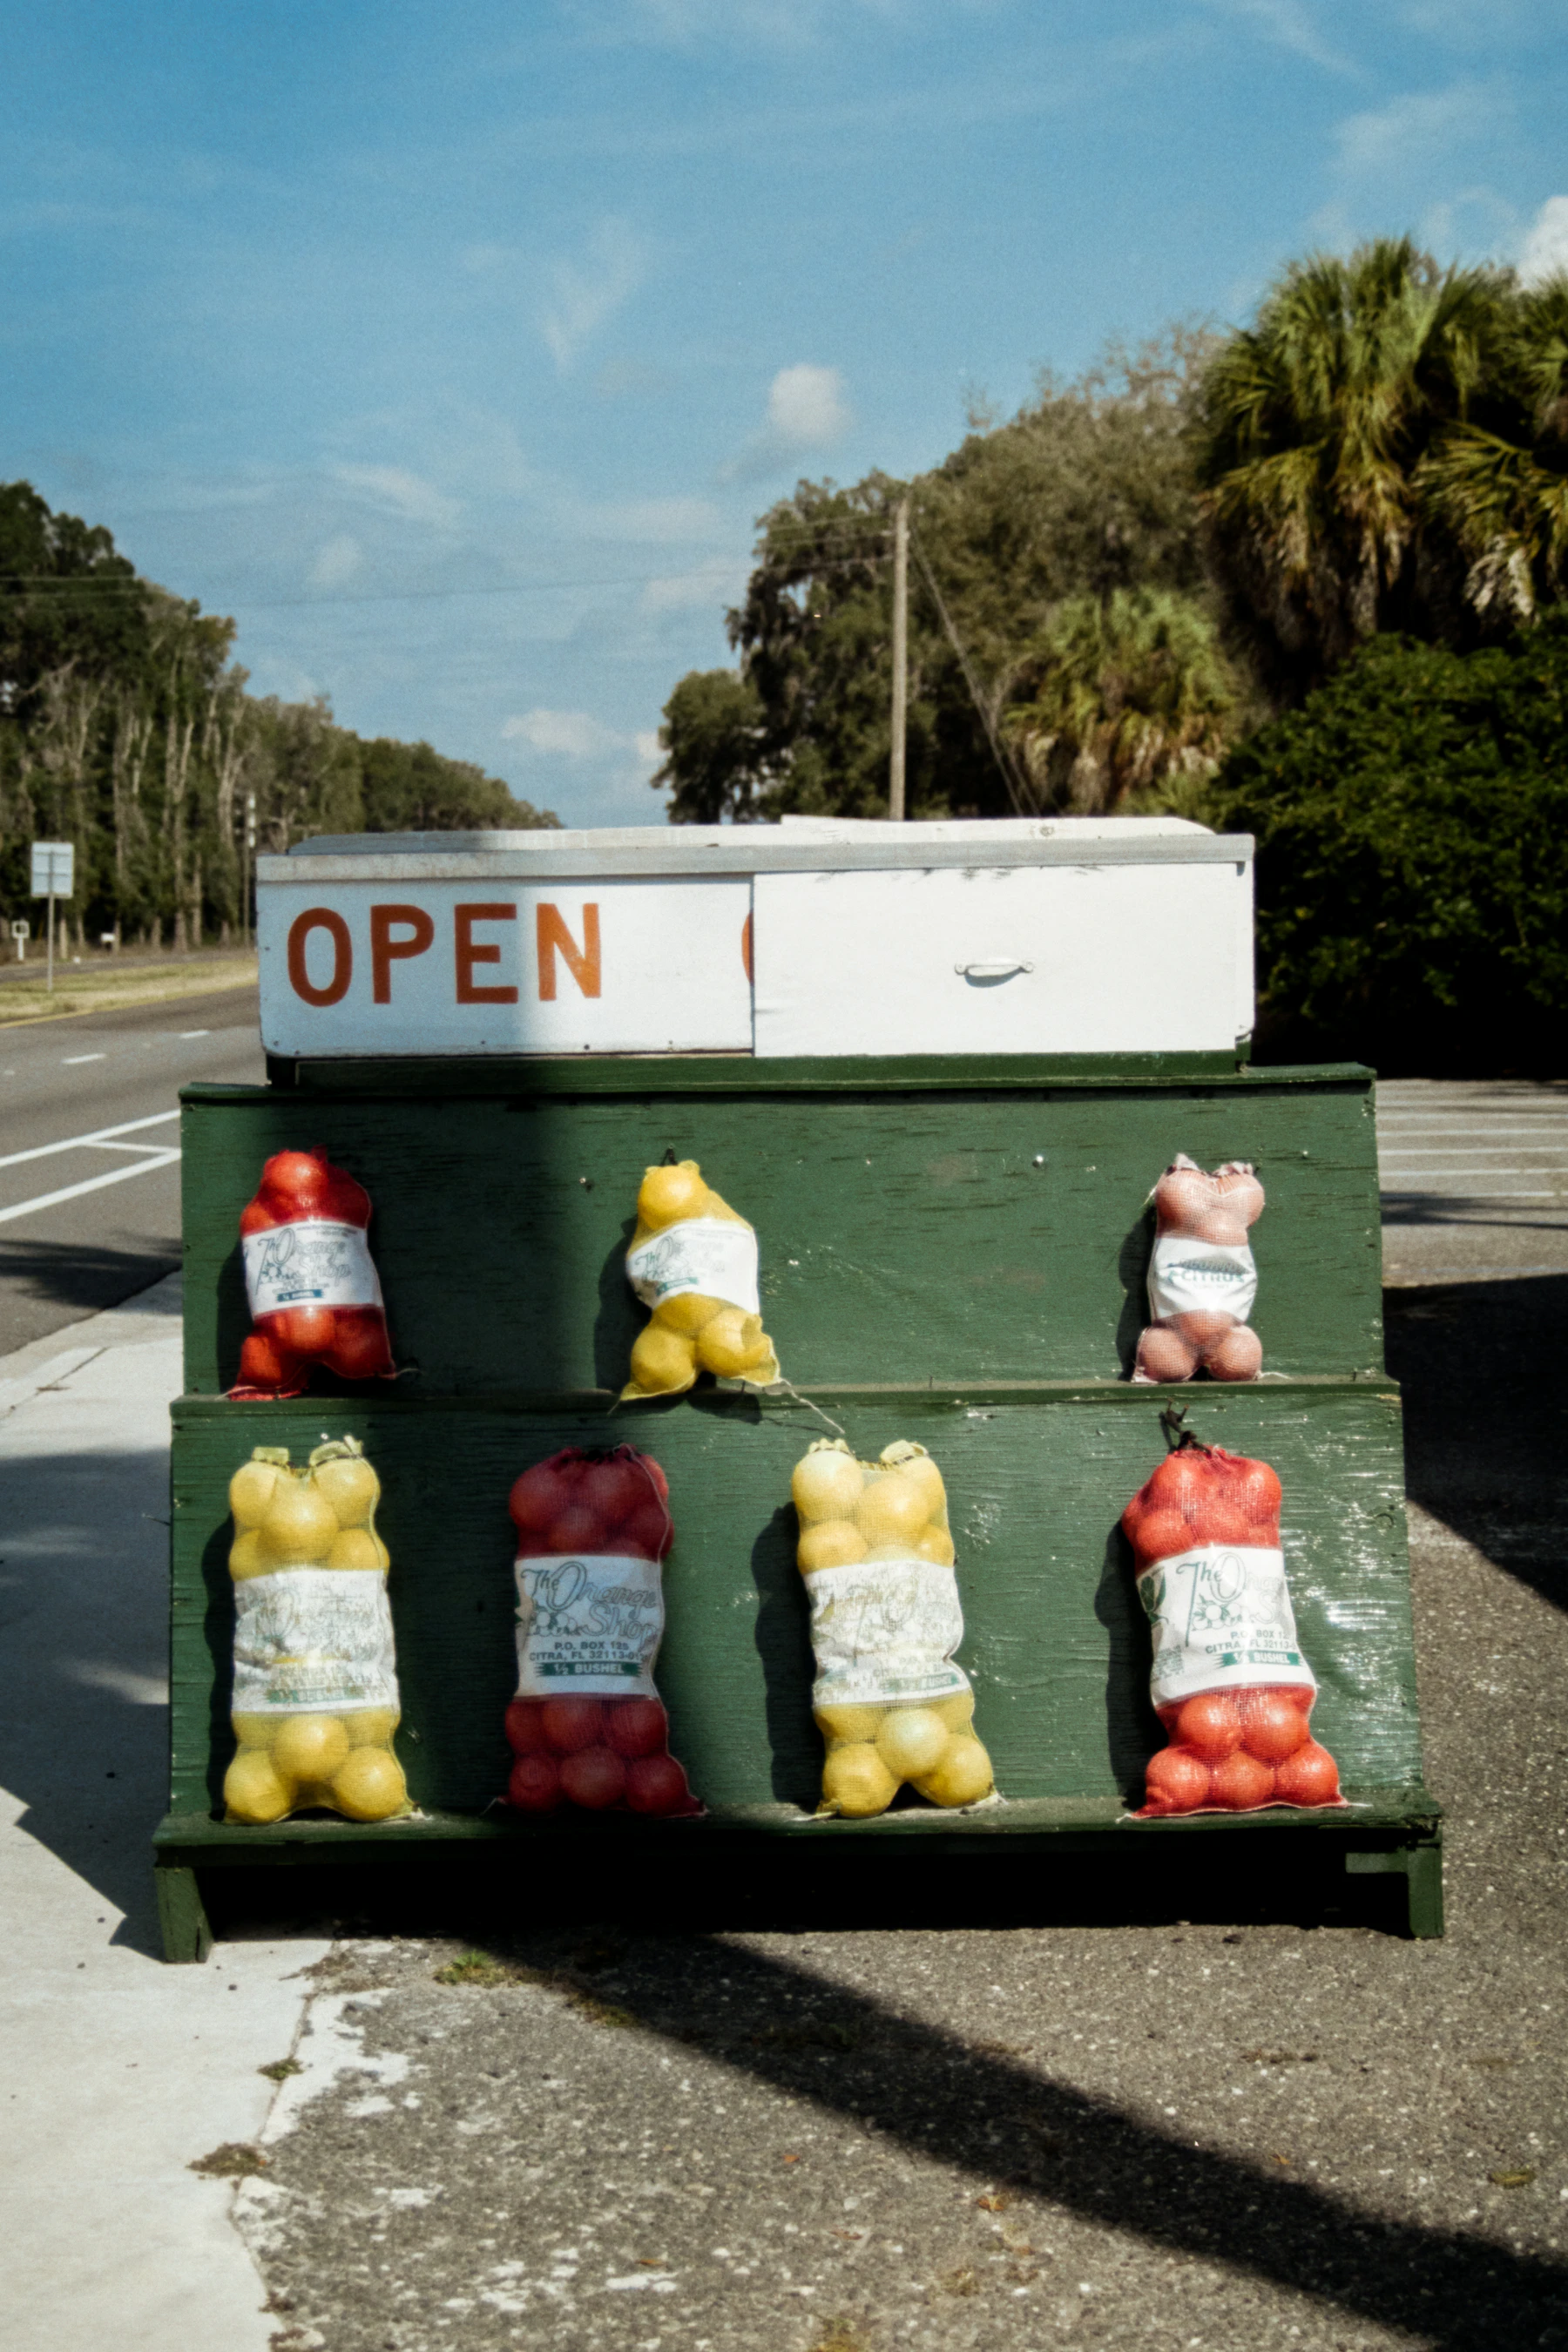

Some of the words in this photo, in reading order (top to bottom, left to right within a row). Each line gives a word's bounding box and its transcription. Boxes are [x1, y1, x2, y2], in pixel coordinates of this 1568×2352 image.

[287, 902, 602, 1008] OPEN
[520, 1567, 560, 1608] The
[545, 1560, 657, 1620] Orange
[1175, 1560, 1223, 1648] The
[580, 1600, 658, 1652] Shop
[1255, 1628, 1274, 1639] BOX
[554, 1641, 577, 1651] P.O.
[580, 1641, 605, 1650] BOX
[1248, 1639, 1260, 1647] FL
[529, 1652, 567, 1661] CITRA,
[571, 1651, 585, 1659] FL
[1253, 1652, 1290, 1663] BUSHEL
[574, 1663, 624, 1674] BUSHEL
